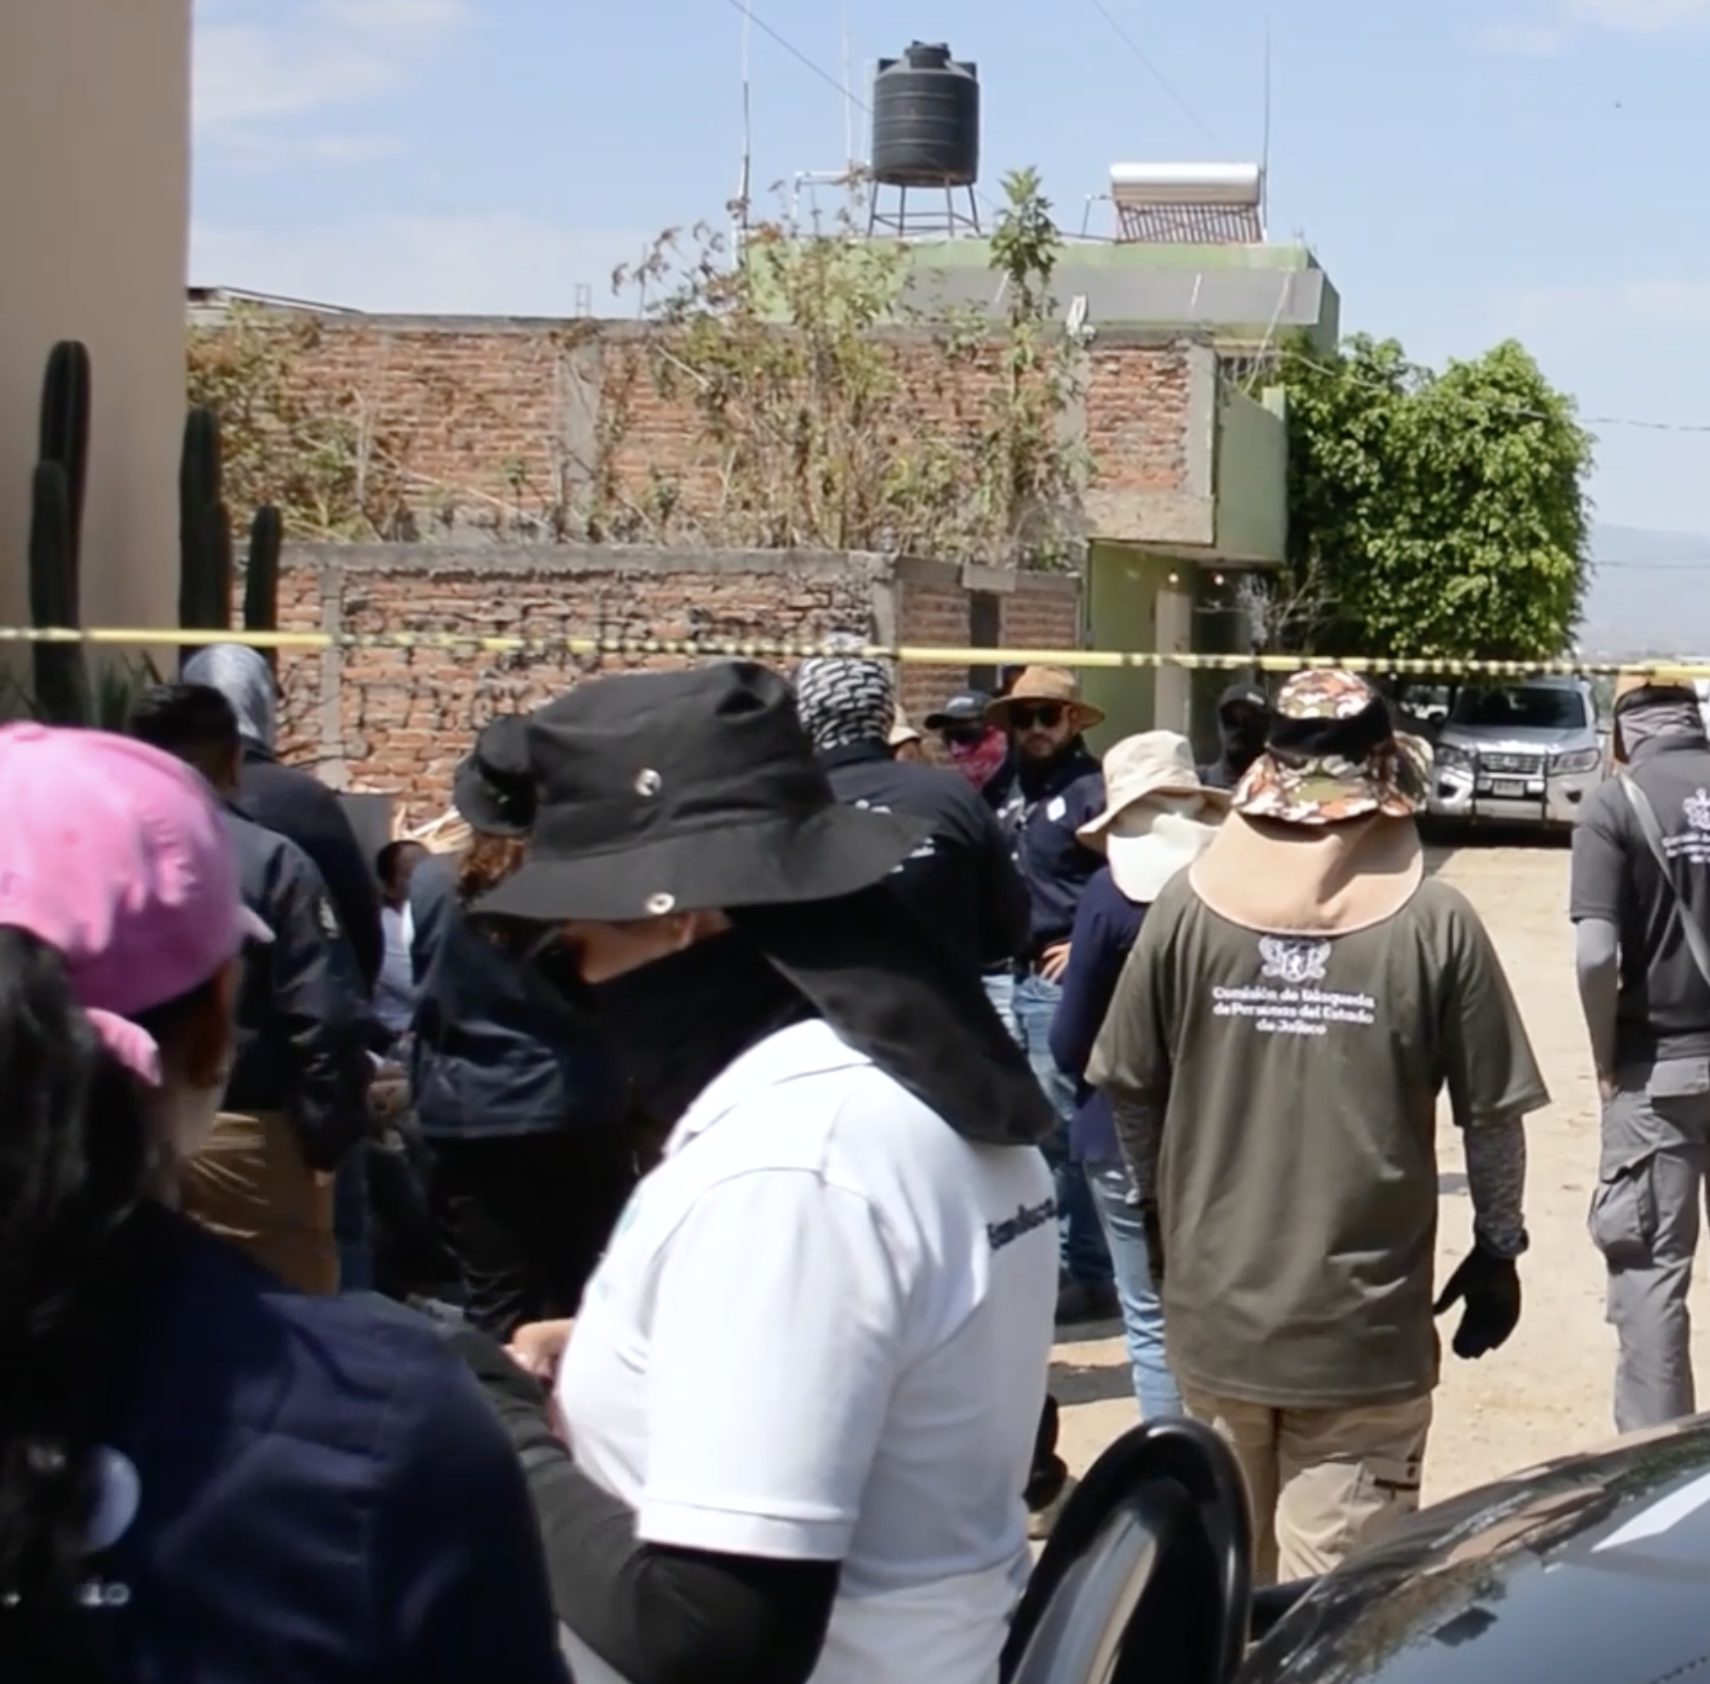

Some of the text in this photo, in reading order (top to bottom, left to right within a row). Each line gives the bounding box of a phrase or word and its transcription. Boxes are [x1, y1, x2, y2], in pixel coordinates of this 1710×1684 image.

[1212, 985, 1277, 1001] Comisión
[1280, 986, 1299, 1001] de
[1212, 1001, 1375, 1024] de Personas del Estado
[1255, 1018, 1276, 1032] de
